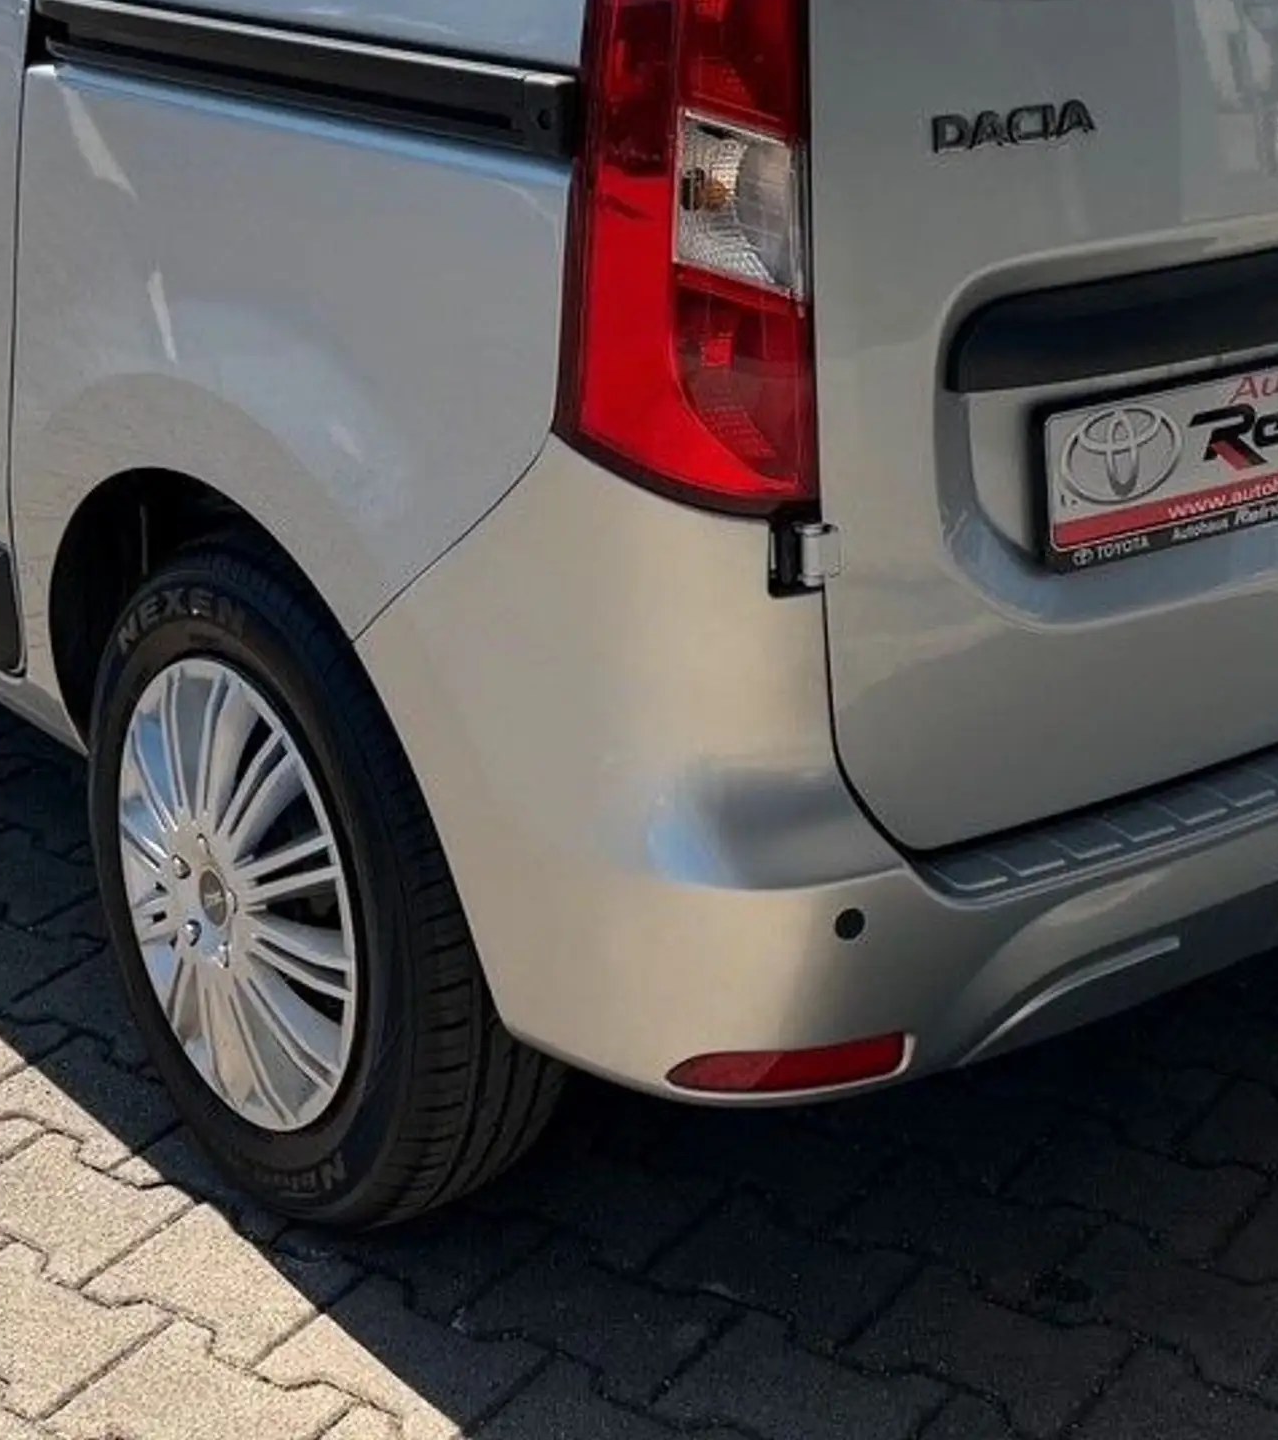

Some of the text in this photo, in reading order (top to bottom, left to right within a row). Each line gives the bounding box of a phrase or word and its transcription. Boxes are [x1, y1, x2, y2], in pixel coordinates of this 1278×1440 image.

[931, 99, 1097, 154] DACIA
[1097, 535, 1151, 560] TOYOTA
[118, 587, 246, 655] NEXEN
